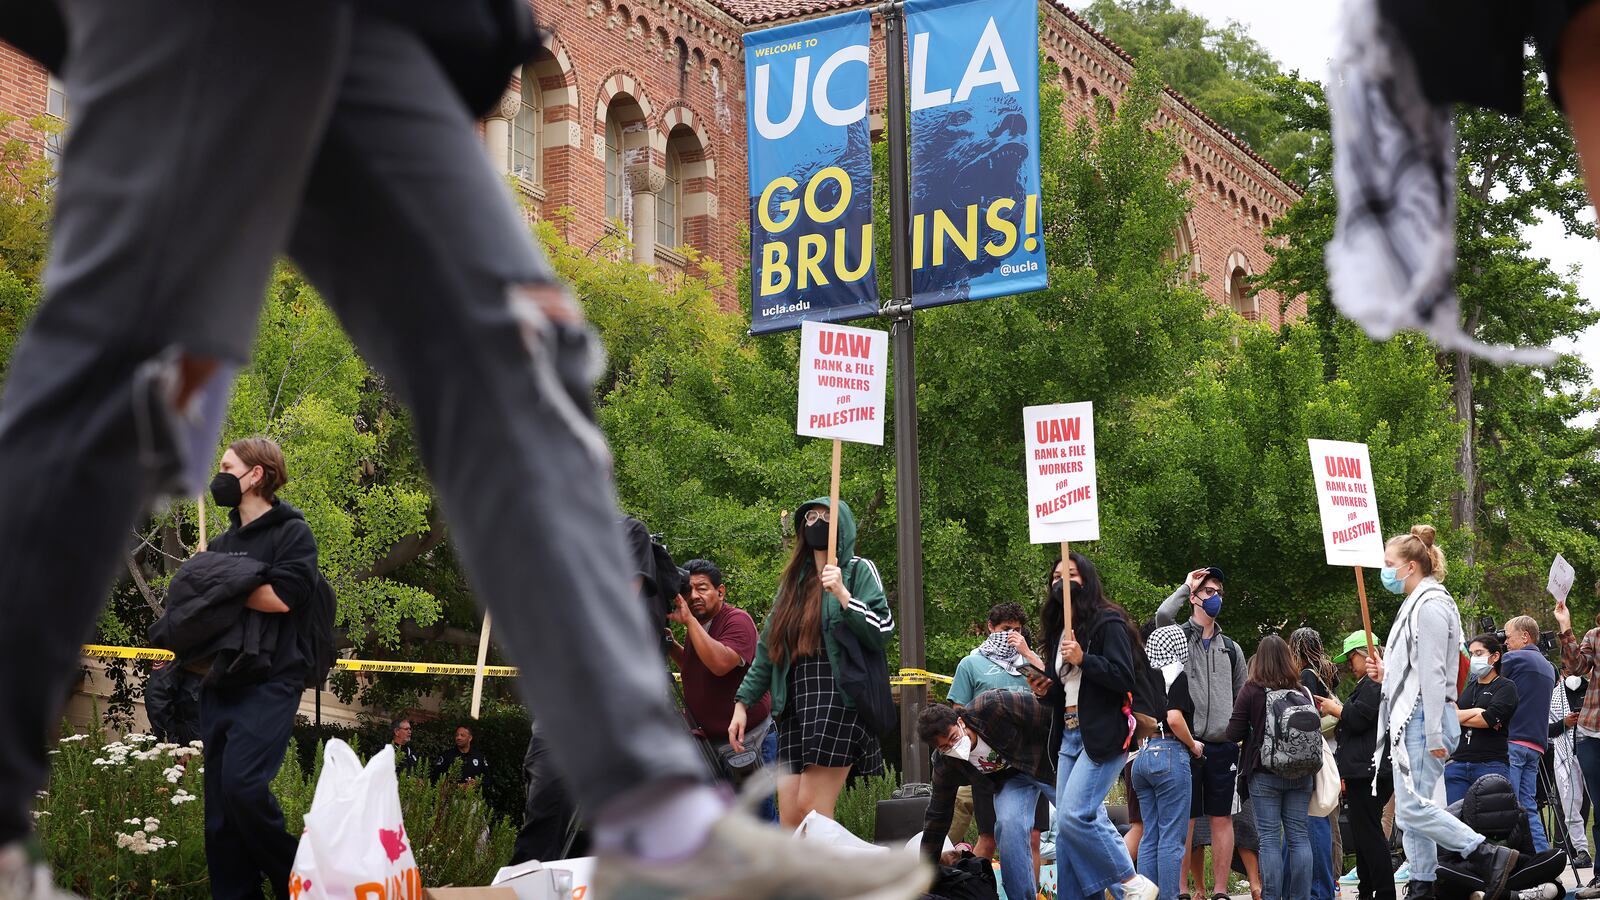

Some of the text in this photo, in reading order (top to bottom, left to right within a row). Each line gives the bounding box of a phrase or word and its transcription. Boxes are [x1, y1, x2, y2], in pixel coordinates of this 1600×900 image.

[755, 38, 818, 58] WELCOME TO
[757, 166, 853, 234] GO
[1000, 260, 1039, 277] @ucla
[762, 300, 811, 317] ucla.edu
[819, 330, 872, 360] UAW
[814, 358, 875, 376] RANK & FILE
[817, 375, 870, 392] WORKERS
[836, 394, 851, 405] FOR
[809, 406, 875, 429] PALESTINE
[1036, 416, 1081, 444] UAW
[1034, 444, 1087, 460] RANK & FILE
[1038, 461, 1084, 476] WORKERS
[1324, 455, 1362, 479] UAW
[1055, 478, 1068, 491] FOR
[1325, 480, 1368, 494] RANK & FILE
[1035, 485, 1091, 519] PALESTINE
[1330, 495, 1368, 508] WORKERS
[1347, 511, 1357, 522] FOR
[1332, 520, 1376, 545] PALESTINE
